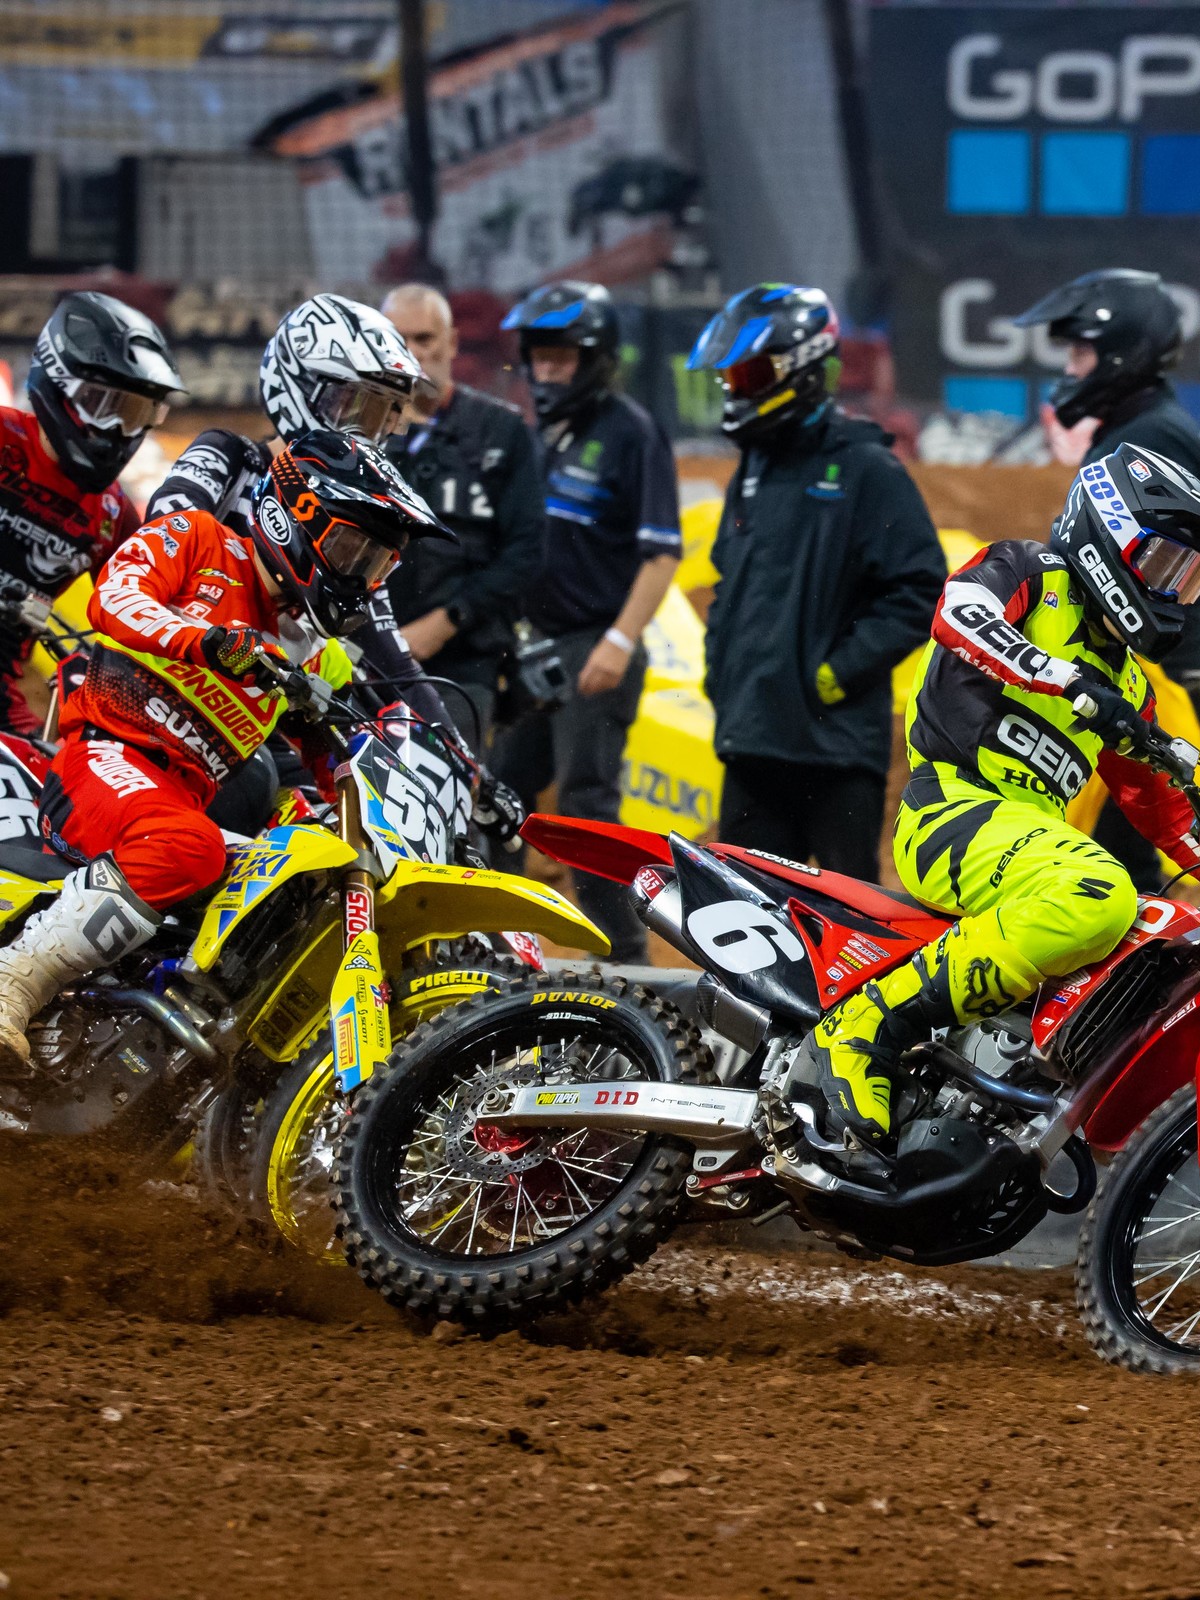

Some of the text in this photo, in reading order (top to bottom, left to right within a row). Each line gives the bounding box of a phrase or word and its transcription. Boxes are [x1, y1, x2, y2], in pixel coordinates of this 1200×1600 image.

[354, 46, 602, 197] RNTALS
[0, 507, 78, 560] HOENIX
[262, 503, 289, 539] Arai
[1077, 543, 1143, 633] GEICO
[620, 759, 714, 827] UZUKI
[745, 848, 820, 877] HONDA
[989, 827, 1049, 889] GEICO
[475, 873, 502, 881] TOYOTA
[687, 900, 805, 975] 6
[409, 969, 490, 993] PIRELLI
[530, 991, 618, 1010] DUNLOP
[338, 1016, 354, 1067] PIRELLI
[361, 1016, 369, 1045] SCOTT
[125, 1047, 152, 1075] SUZUKI
[650, 1097, 727, 1111] INTENSE
